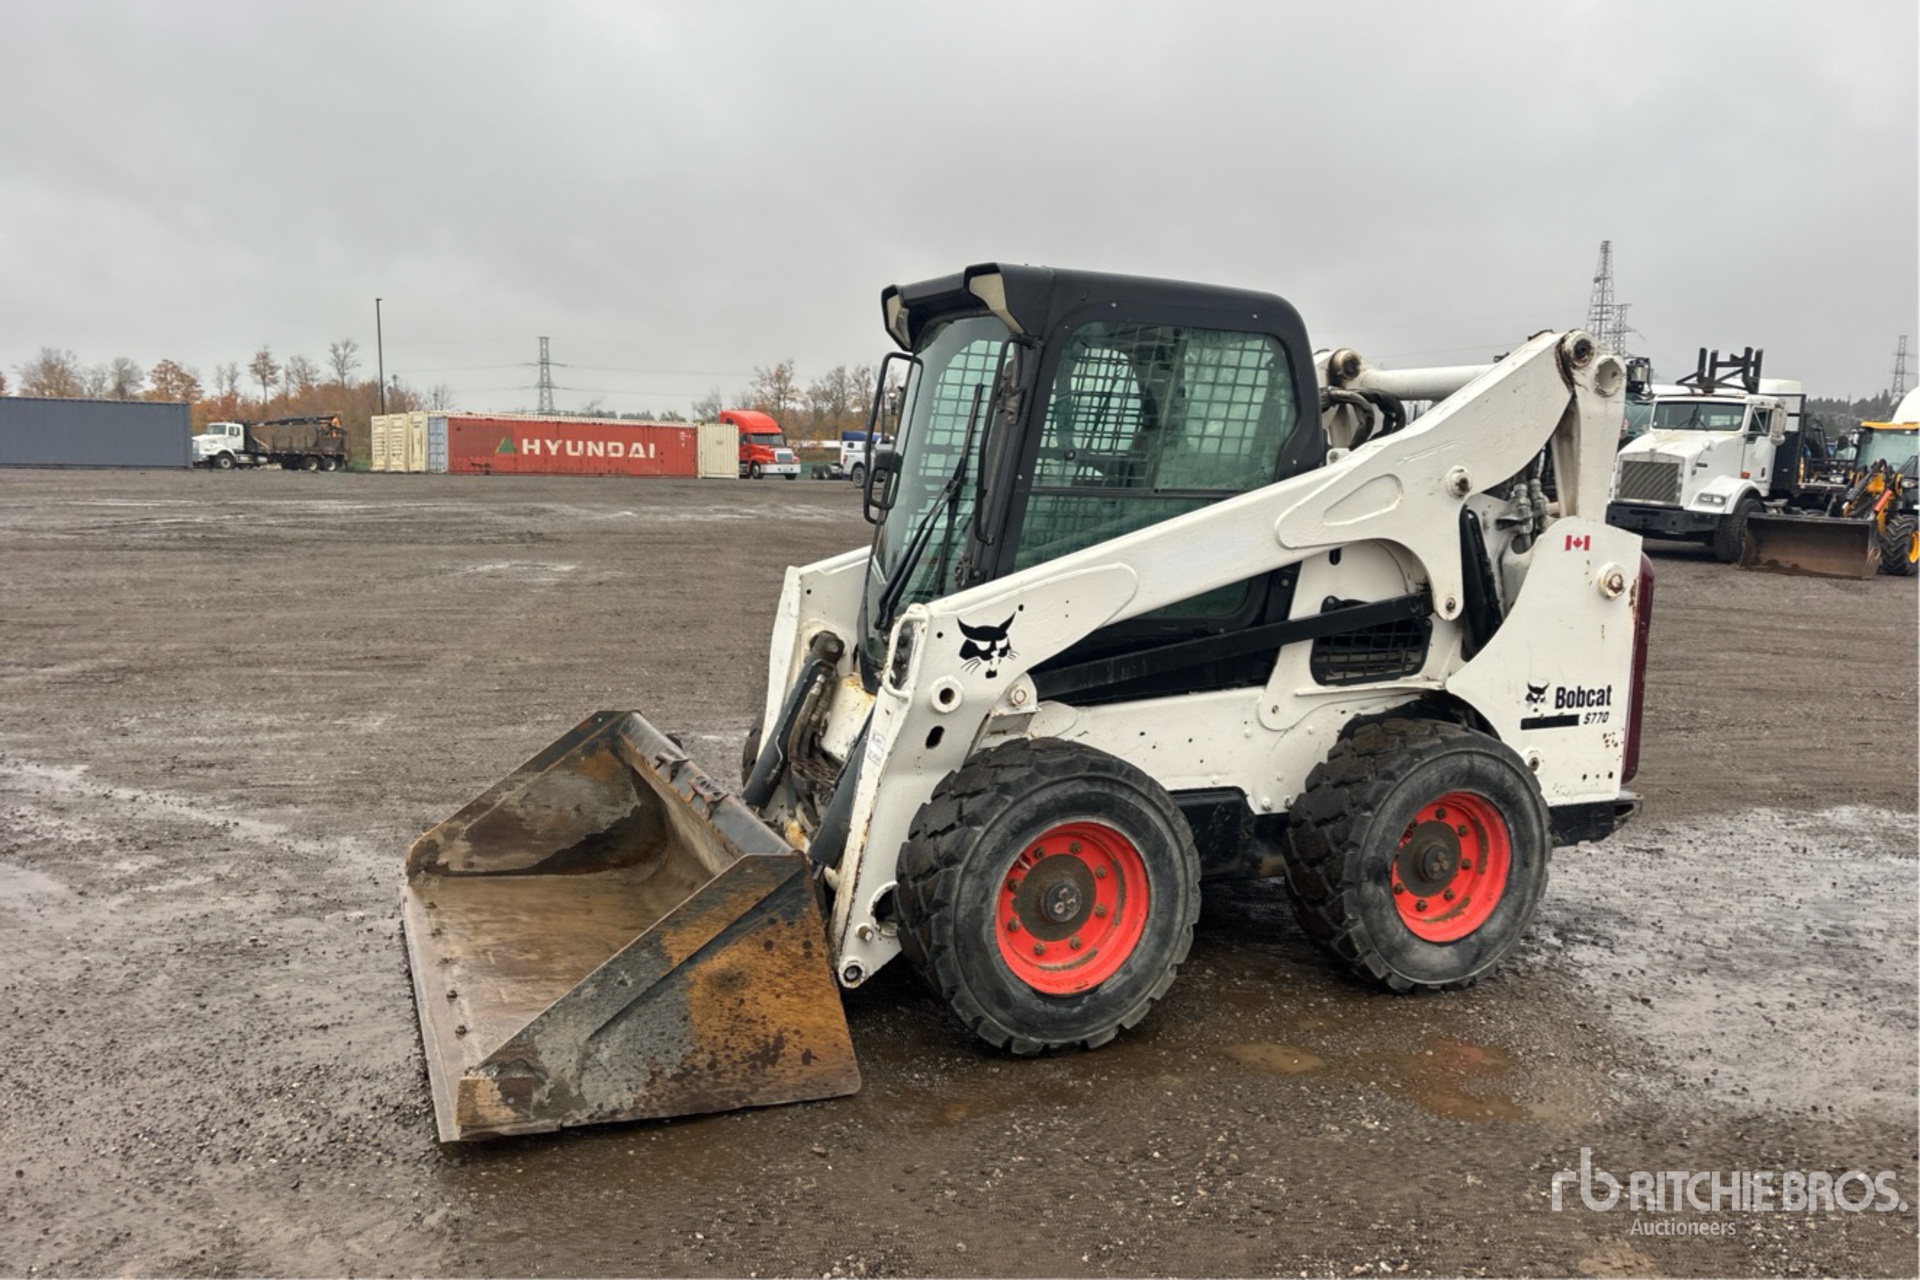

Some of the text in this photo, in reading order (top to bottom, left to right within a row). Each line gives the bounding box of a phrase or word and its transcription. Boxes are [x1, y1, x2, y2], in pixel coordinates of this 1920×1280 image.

[522, 438, 656, 459] HYUNDAI
[1555, 685, 1612, 709] Bobcat
[1583, 711, 1610, 725] S770
